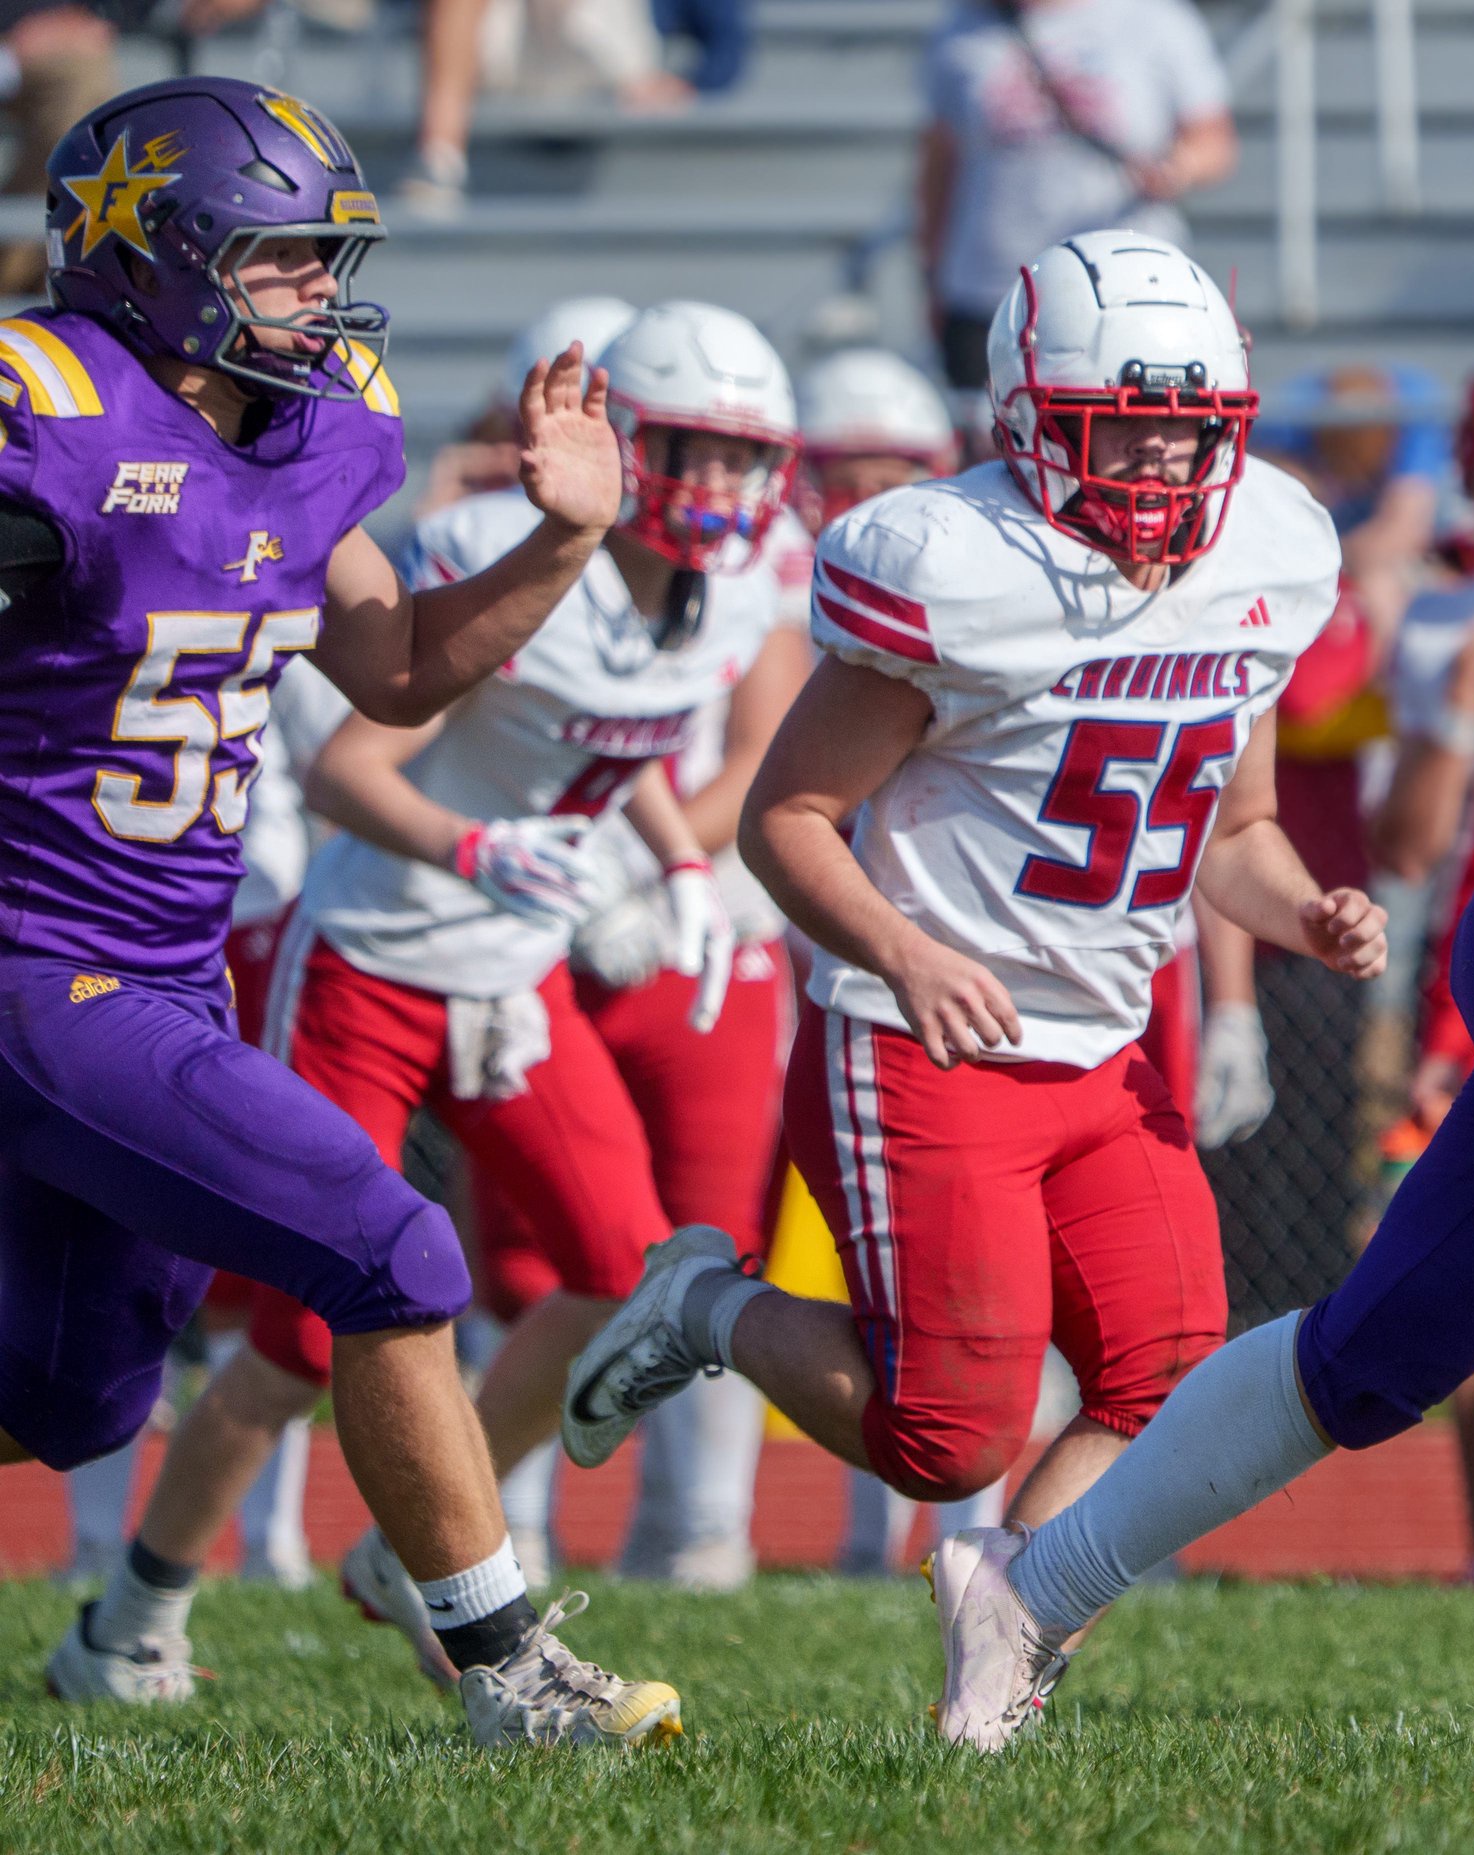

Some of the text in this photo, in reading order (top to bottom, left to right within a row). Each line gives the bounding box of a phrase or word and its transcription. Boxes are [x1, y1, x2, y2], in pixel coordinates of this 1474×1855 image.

[98, 181, 129, 223] F
[113, 461, 190, 489] FEAR
[101, 487, 180, 514] FORK
[1050, 650, 1257, 699] CARDINALS
[92, 606, 319, 843] 55
[1012, 712, 1236, 914] 55
[69, 974, 120, 1004] adidas
